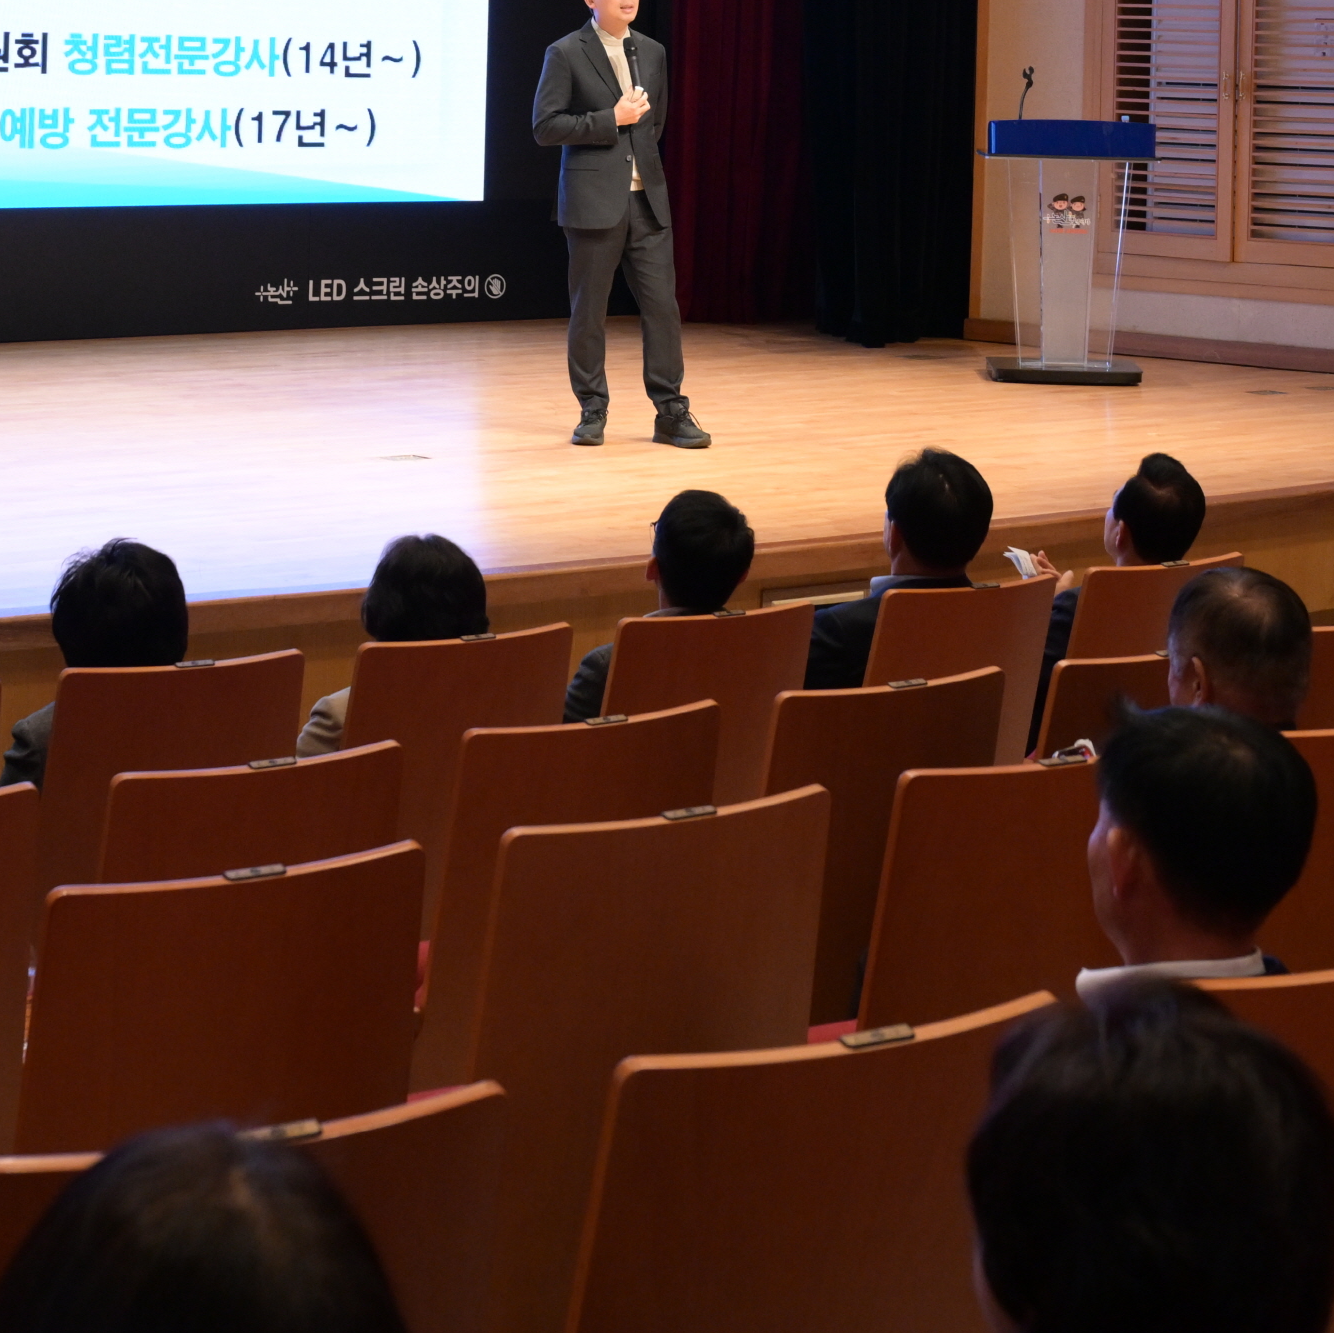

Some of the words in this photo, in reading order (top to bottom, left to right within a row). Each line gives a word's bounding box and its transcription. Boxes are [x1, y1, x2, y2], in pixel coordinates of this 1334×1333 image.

[0, 105, 74, 150] 예방
[309, 279, 347, 302] LED
[353, 277, 406, 300] 스크린
[411, 275, 479, 300] 손상주의
